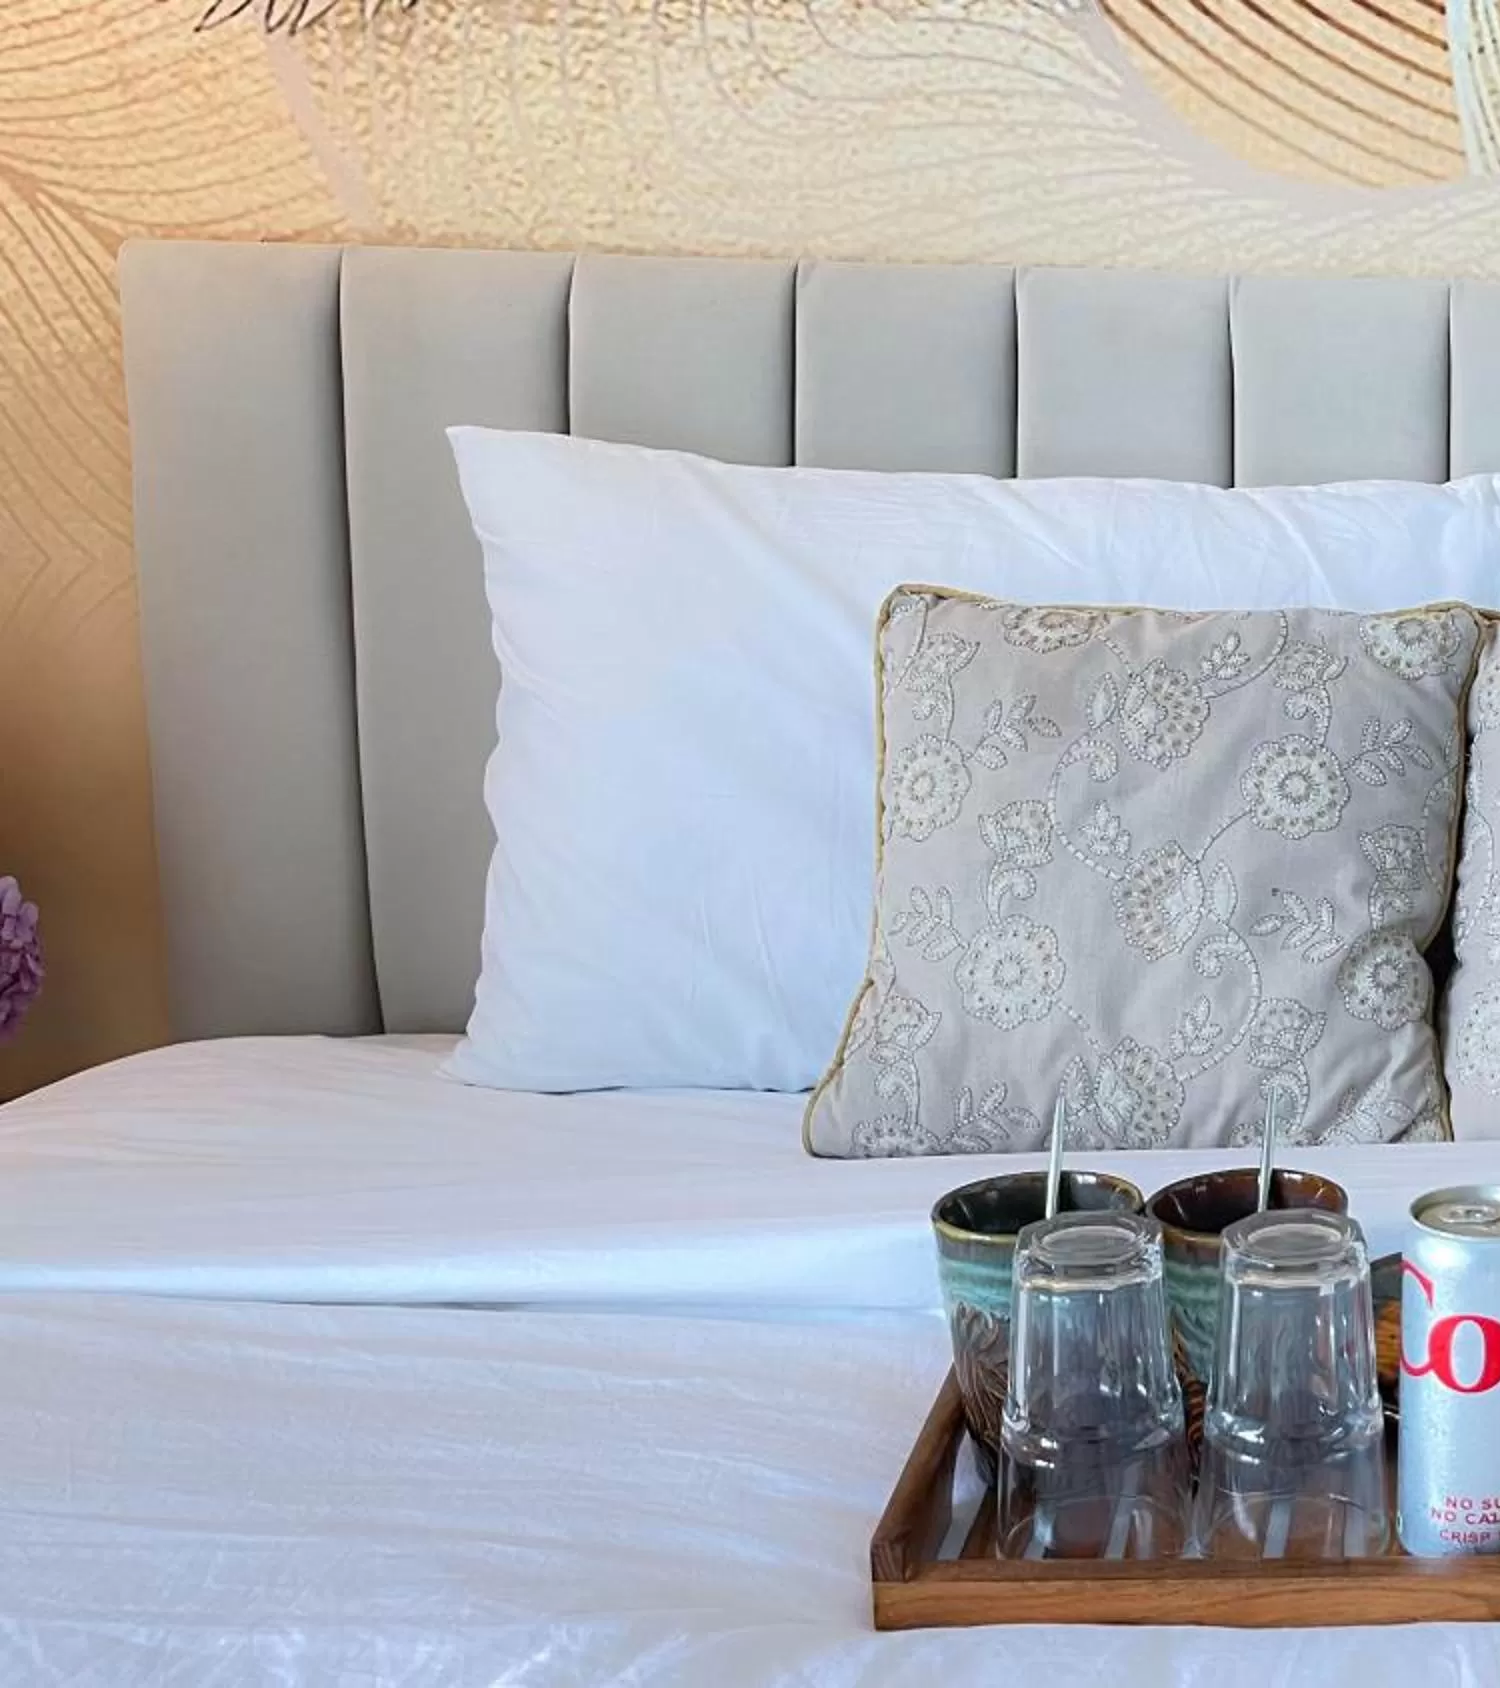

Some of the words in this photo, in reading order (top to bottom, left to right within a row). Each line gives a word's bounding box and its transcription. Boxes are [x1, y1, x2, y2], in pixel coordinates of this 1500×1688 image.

[1446, 1496, 1473, 1511] NO
[1431, 1507, 1457, 1523] NO
[1440, 1529, 1491, 1544] CRISP
